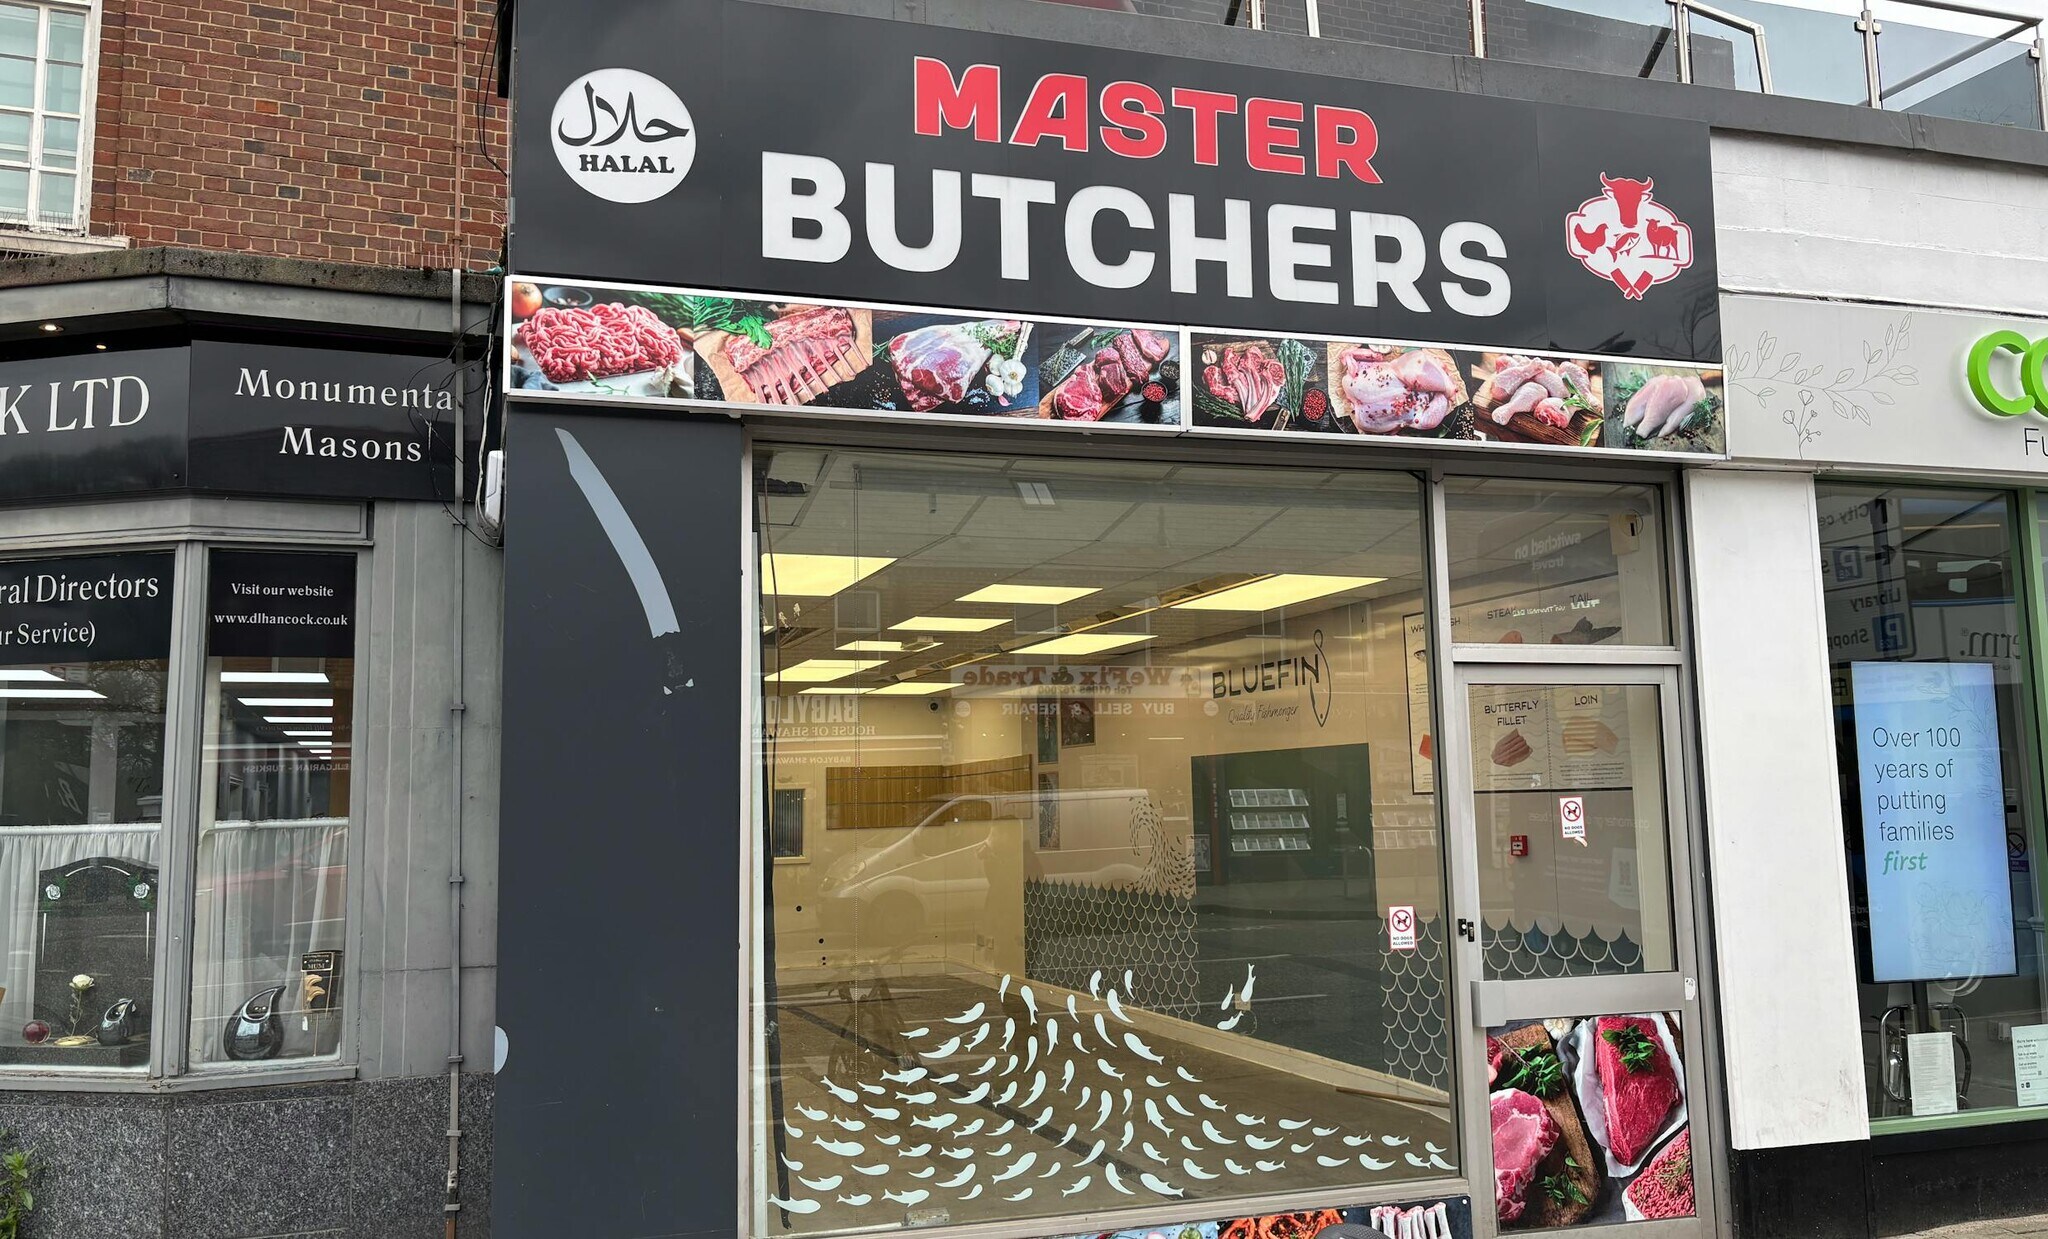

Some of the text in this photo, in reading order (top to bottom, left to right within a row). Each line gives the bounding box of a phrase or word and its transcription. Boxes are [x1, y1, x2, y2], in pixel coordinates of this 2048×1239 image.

[558, 81, 690, 146] حلال
[914, 56, 1382, 185] MASTER
[579, 154, 675, 174] HALAL
[761, 151, 1513, 318] BUTCHERS
[47, 374, 151, 433] LTD
[279, 426, 422, 462] Masons
[36, 572, 159, 602] Directors
[231, 583, 334, 597] Visit our website
[214, 612, 348, 626] www.dlhancock.co.uk
[17, 620, 96, 648] Service)
[1212, 654, 1320, 698] BLUEFIN
[1484, 700, 1539, 714] BUTTERFLY
[1574, 695, 1598, 706] LOIN
[1497, 715, 1527, 726] FILLET
[1873, 727, 1961, 748] Over 100
[1874, 758, 1954, 784] years of
[1877, 790, 1946, 815] putting
[1879, 821, 1955, 842] families
[1883, 850, 1928, 875] first
